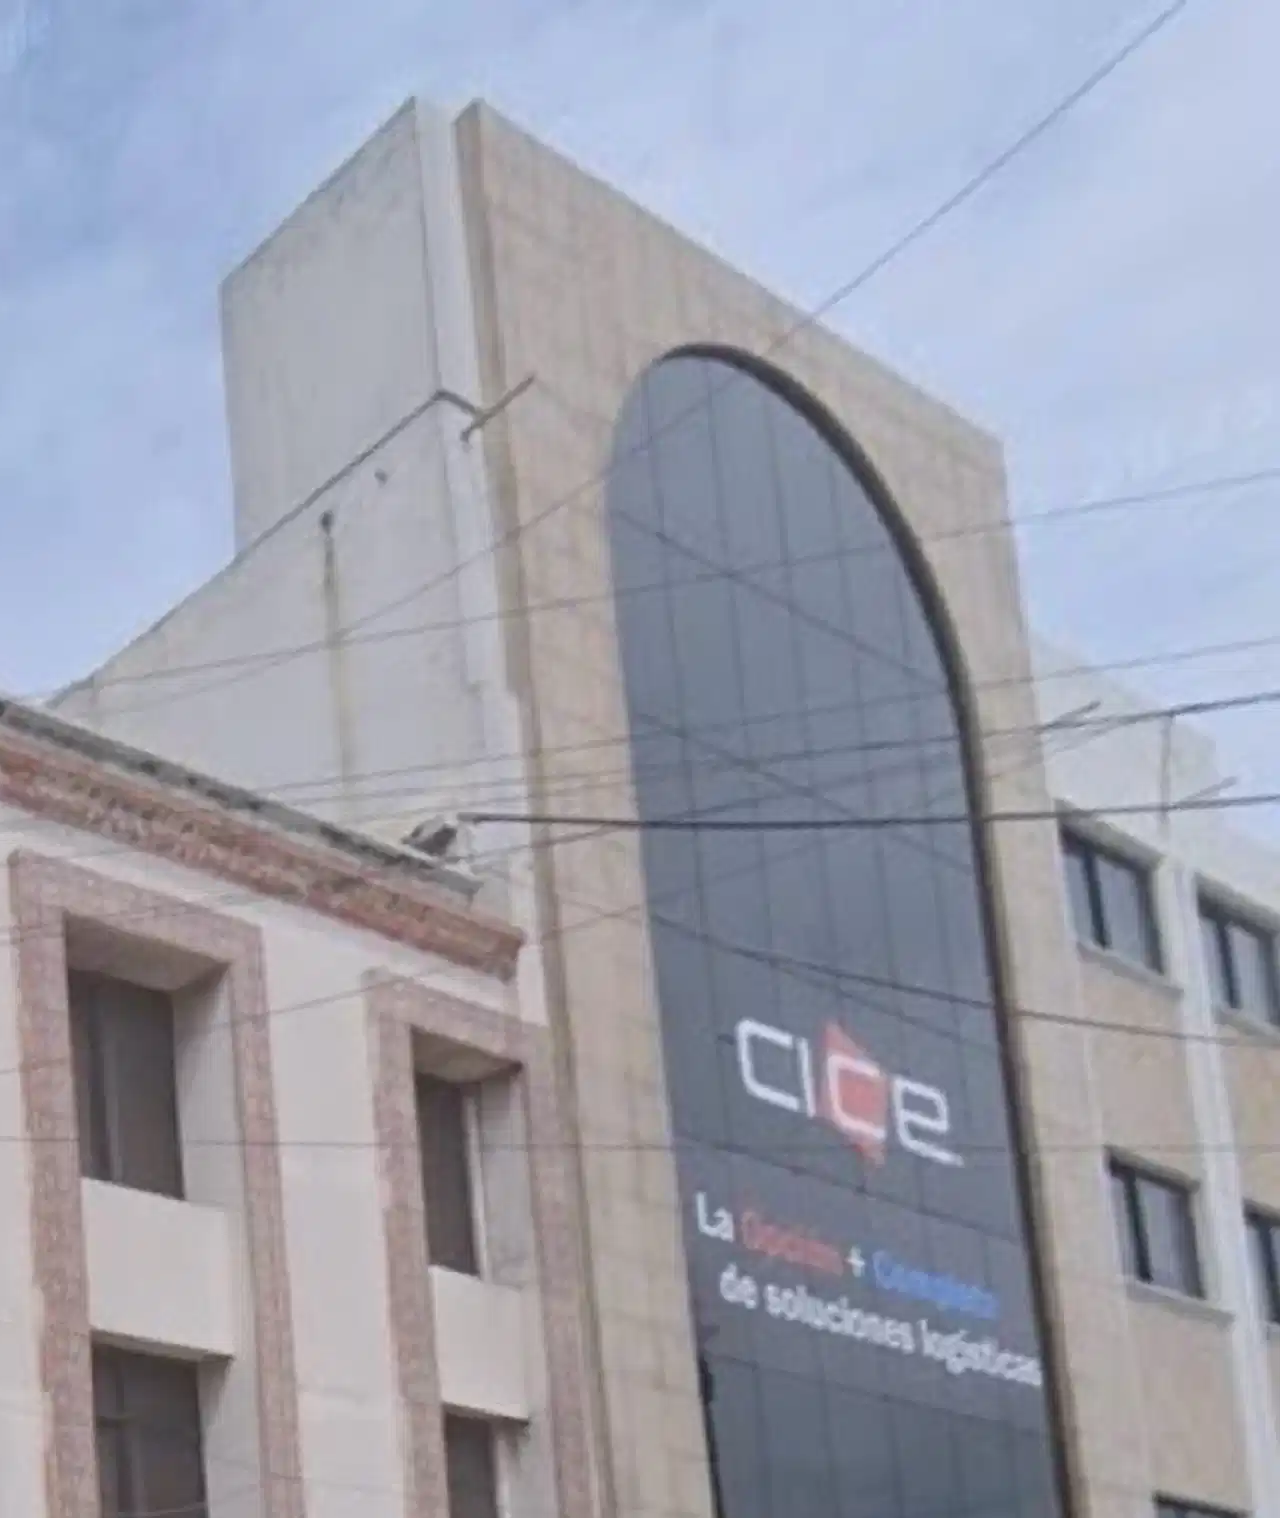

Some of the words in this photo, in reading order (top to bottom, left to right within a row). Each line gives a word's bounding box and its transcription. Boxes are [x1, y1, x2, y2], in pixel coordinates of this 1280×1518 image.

[696, 1191, 735, 1243] La
[719, 1264, 758, 1309] de
[763, 1283, 915, 1354] soluciones
